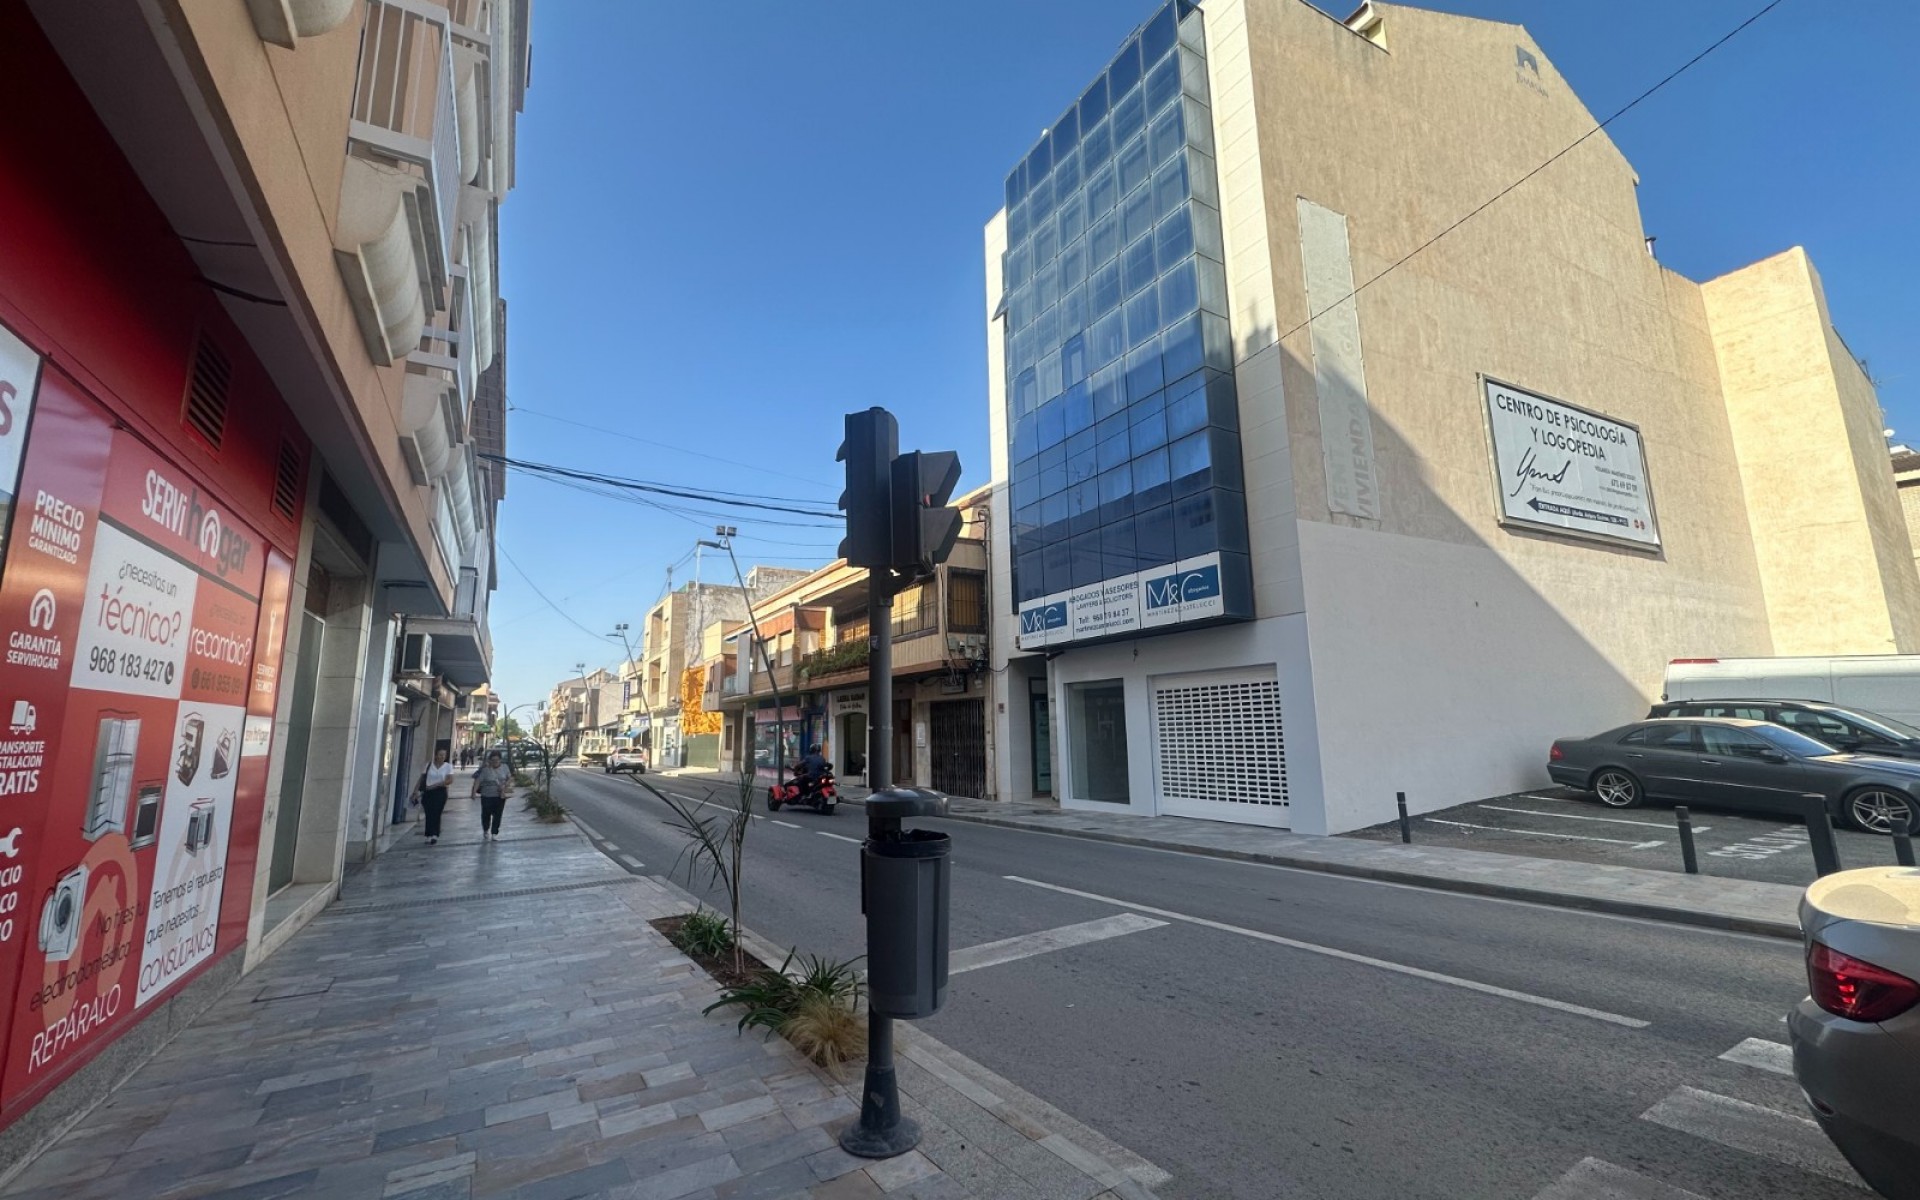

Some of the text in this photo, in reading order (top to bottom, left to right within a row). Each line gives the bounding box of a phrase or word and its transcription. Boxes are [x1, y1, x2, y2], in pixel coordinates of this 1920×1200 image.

[1496, 394, 1627, 447] CENTRO DE PSICOLOGÍA
[1531, 426, 1606, 460] Y LOGOPEDIA
[35, 489, 84, 531] PRECIO
[28, 536, 77, 565] GARANTIZADO
[119, 561, 177, 598] ¿necesitas un
[1105, 581, 1139, 595] ASESORES
[98, 583, 181, 648] técnico?
[6, 650, 59, 670] SERVIHOGAR
[9, 631, 61, 656] GARANTÍA
[189, 626, 252, 667] recambio?
[90, 646, 164, 683] 968 183 427
[0, 741, 45, 755] ANSPORTE
[0, 865, 21, 887] CIO
[153, 881, 187, 910] Tenemos
[187, 874, 195, 893] el
[96, 915, 112, 937] No
[146, 923, 164, 948] que
[140, 923, 215, 993] CONSÚLTANOS
[30, 941, 132, 1012] electrodoméstico
[28, 983, 121, 1074] REPÁRALO
